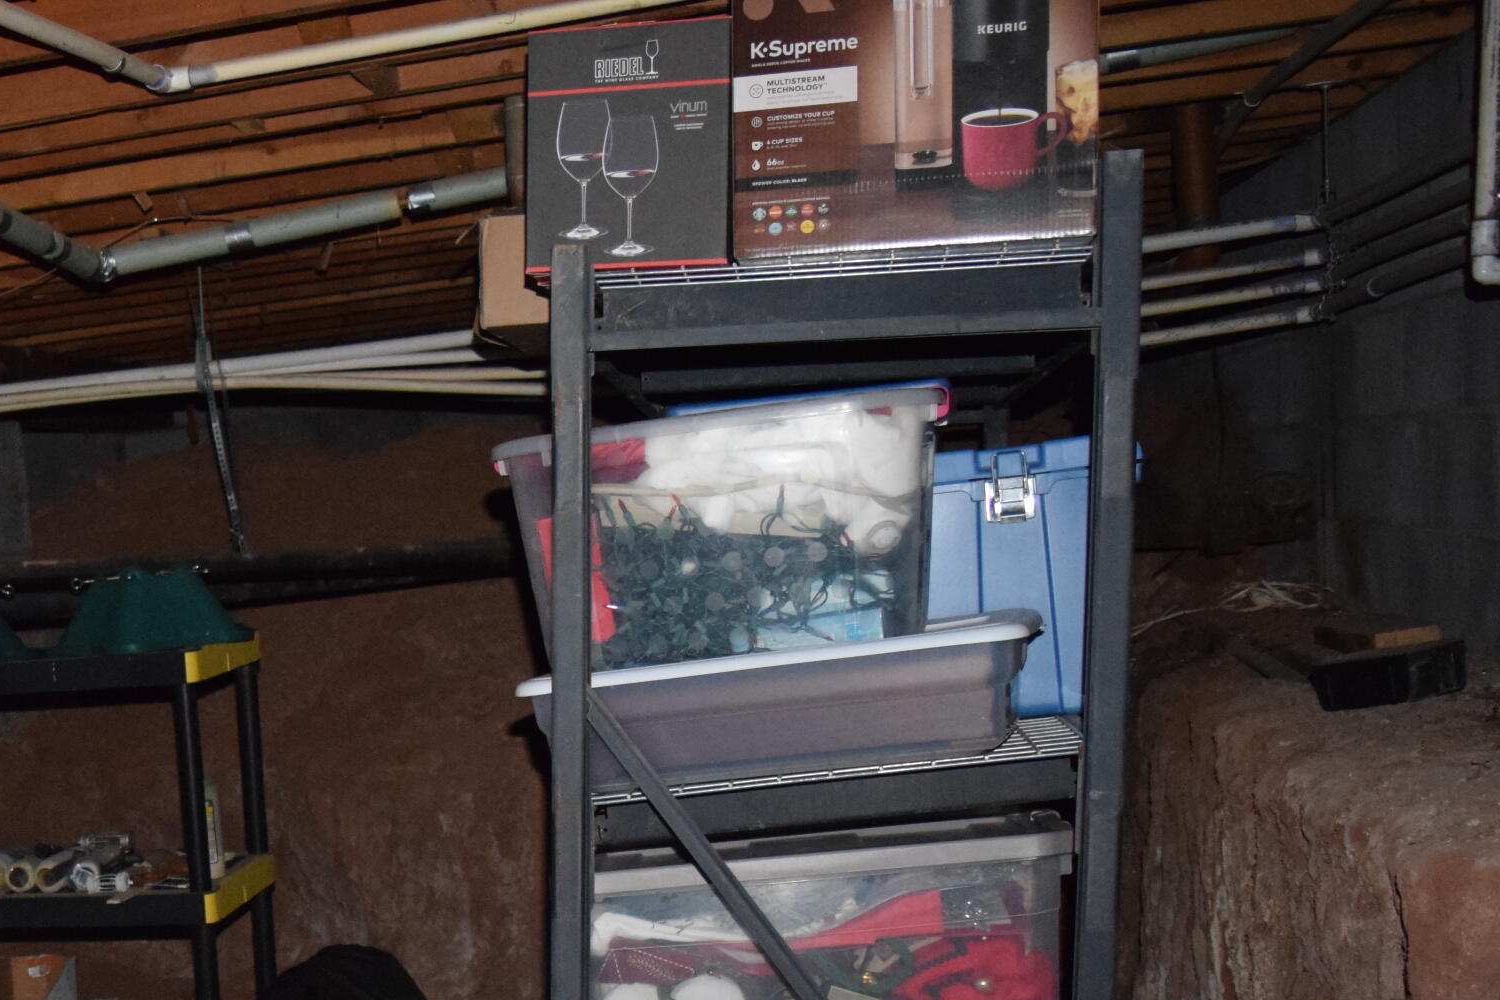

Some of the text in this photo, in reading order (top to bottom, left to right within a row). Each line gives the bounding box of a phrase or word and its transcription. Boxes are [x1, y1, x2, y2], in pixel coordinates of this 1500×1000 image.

[977, 21, 1027, 35] KEURIG
[595, 57, 644, 79] RIEDEL
[766, 75, 825, 87] MULTISTREAM
[669, 100, 708, 113] vinum
[766, 113, 802, 122] CUSTOMIZE
